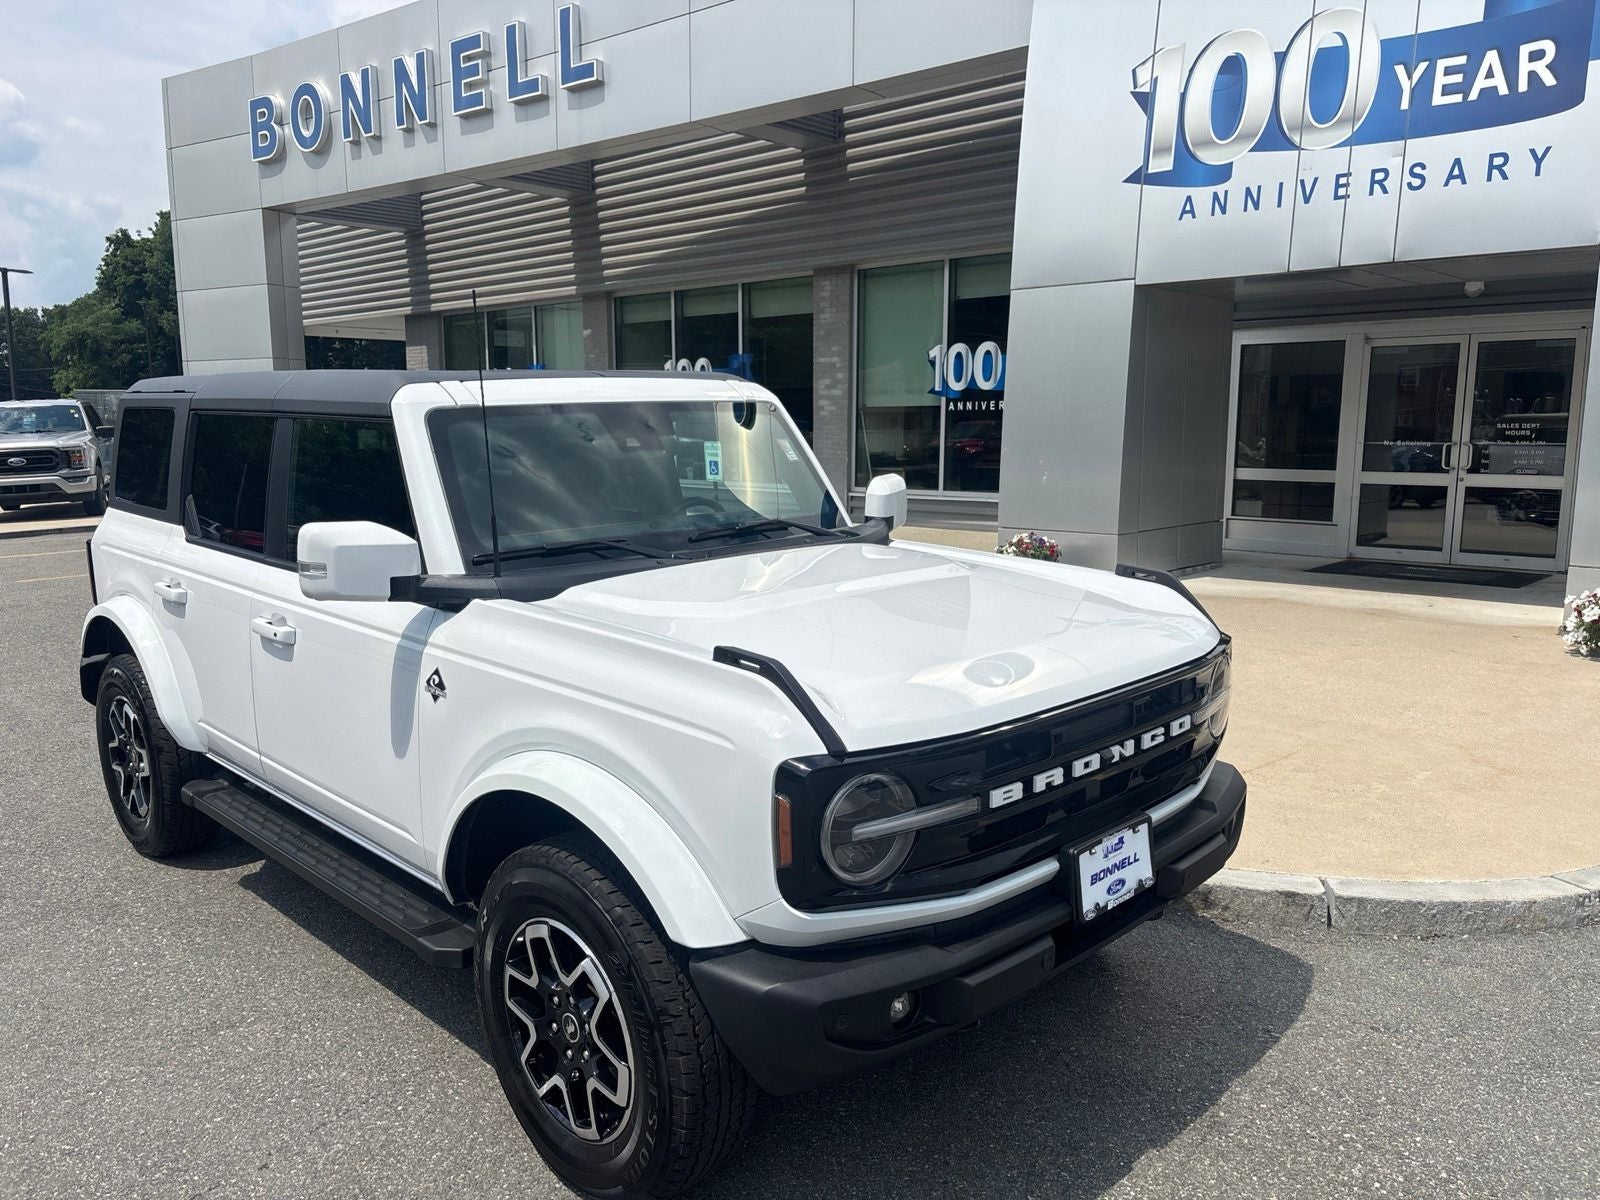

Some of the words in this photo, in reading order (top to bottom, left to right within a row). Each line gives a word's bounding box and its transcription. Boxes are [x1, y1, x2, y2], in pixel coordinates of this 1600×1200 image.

[248, 3, 603, 163] BONNELL
[1132, 8, 1381, 174] 100
[1394, 39, 1557, 111] YEAR
[1178, 146, 1553, 221] ANNIVERSARY
[928, 341, 1003, 392] 100
[948, 400, 1004, 411] ANNIVER
[989, 714, 1191, 808] BRONCO
[1090, 852, 1140, 887] BONNELL
